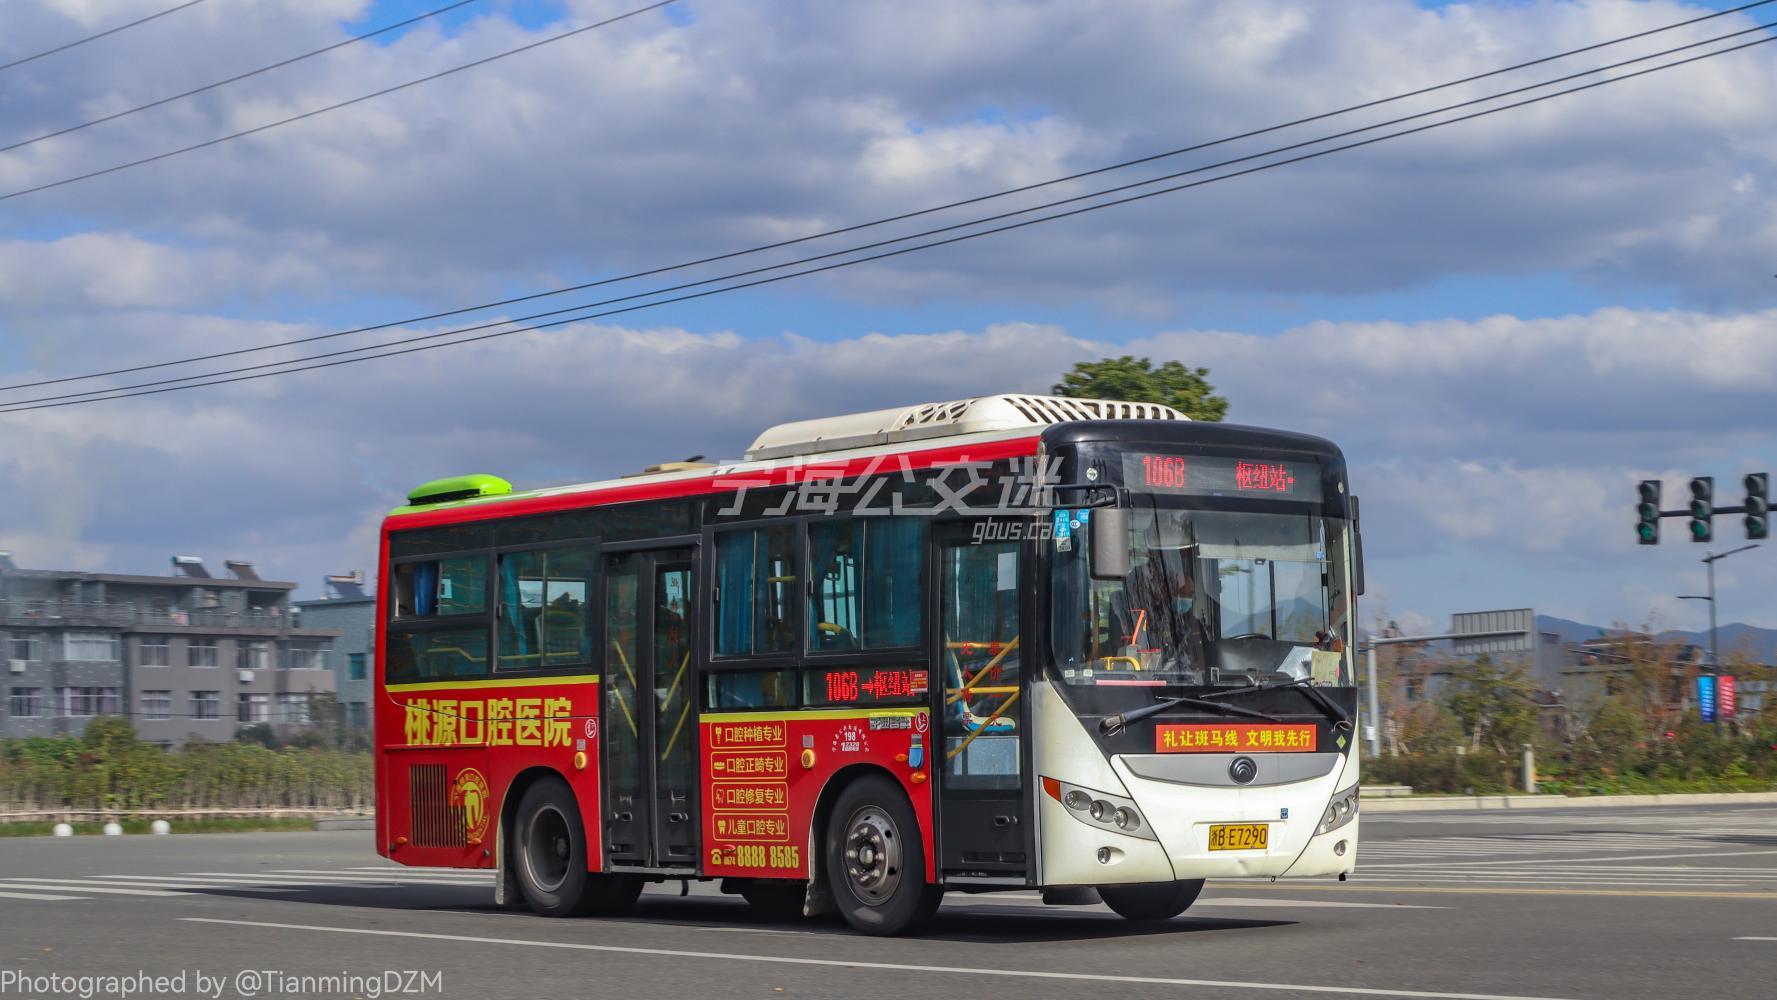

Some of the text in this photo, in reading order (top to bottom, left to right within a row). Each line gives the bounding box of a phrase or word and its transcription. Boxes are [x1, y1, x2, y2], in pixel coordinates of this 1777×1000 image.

[1143, 456, 1287, 492] 106B 枢纽站
[825, 671, 859, 701] 106B
[404, 697, 572, 747] 桃源口腔医院
[725, 725, 783, 743] 口腔种植专业
[844, 731, 856, 741] 198
[1163, 730, 1312, 748] 礼让斑马线 文明我先行
[726, 756, 784, 773] 口腔正畸专业
[726, 788, 784, 804] 口腔修复专业
[728, 819, 785, 836] 儿童口腔专业
[737, 845, 766, 867] 8888
[770, 845, 799, 868] 8585
